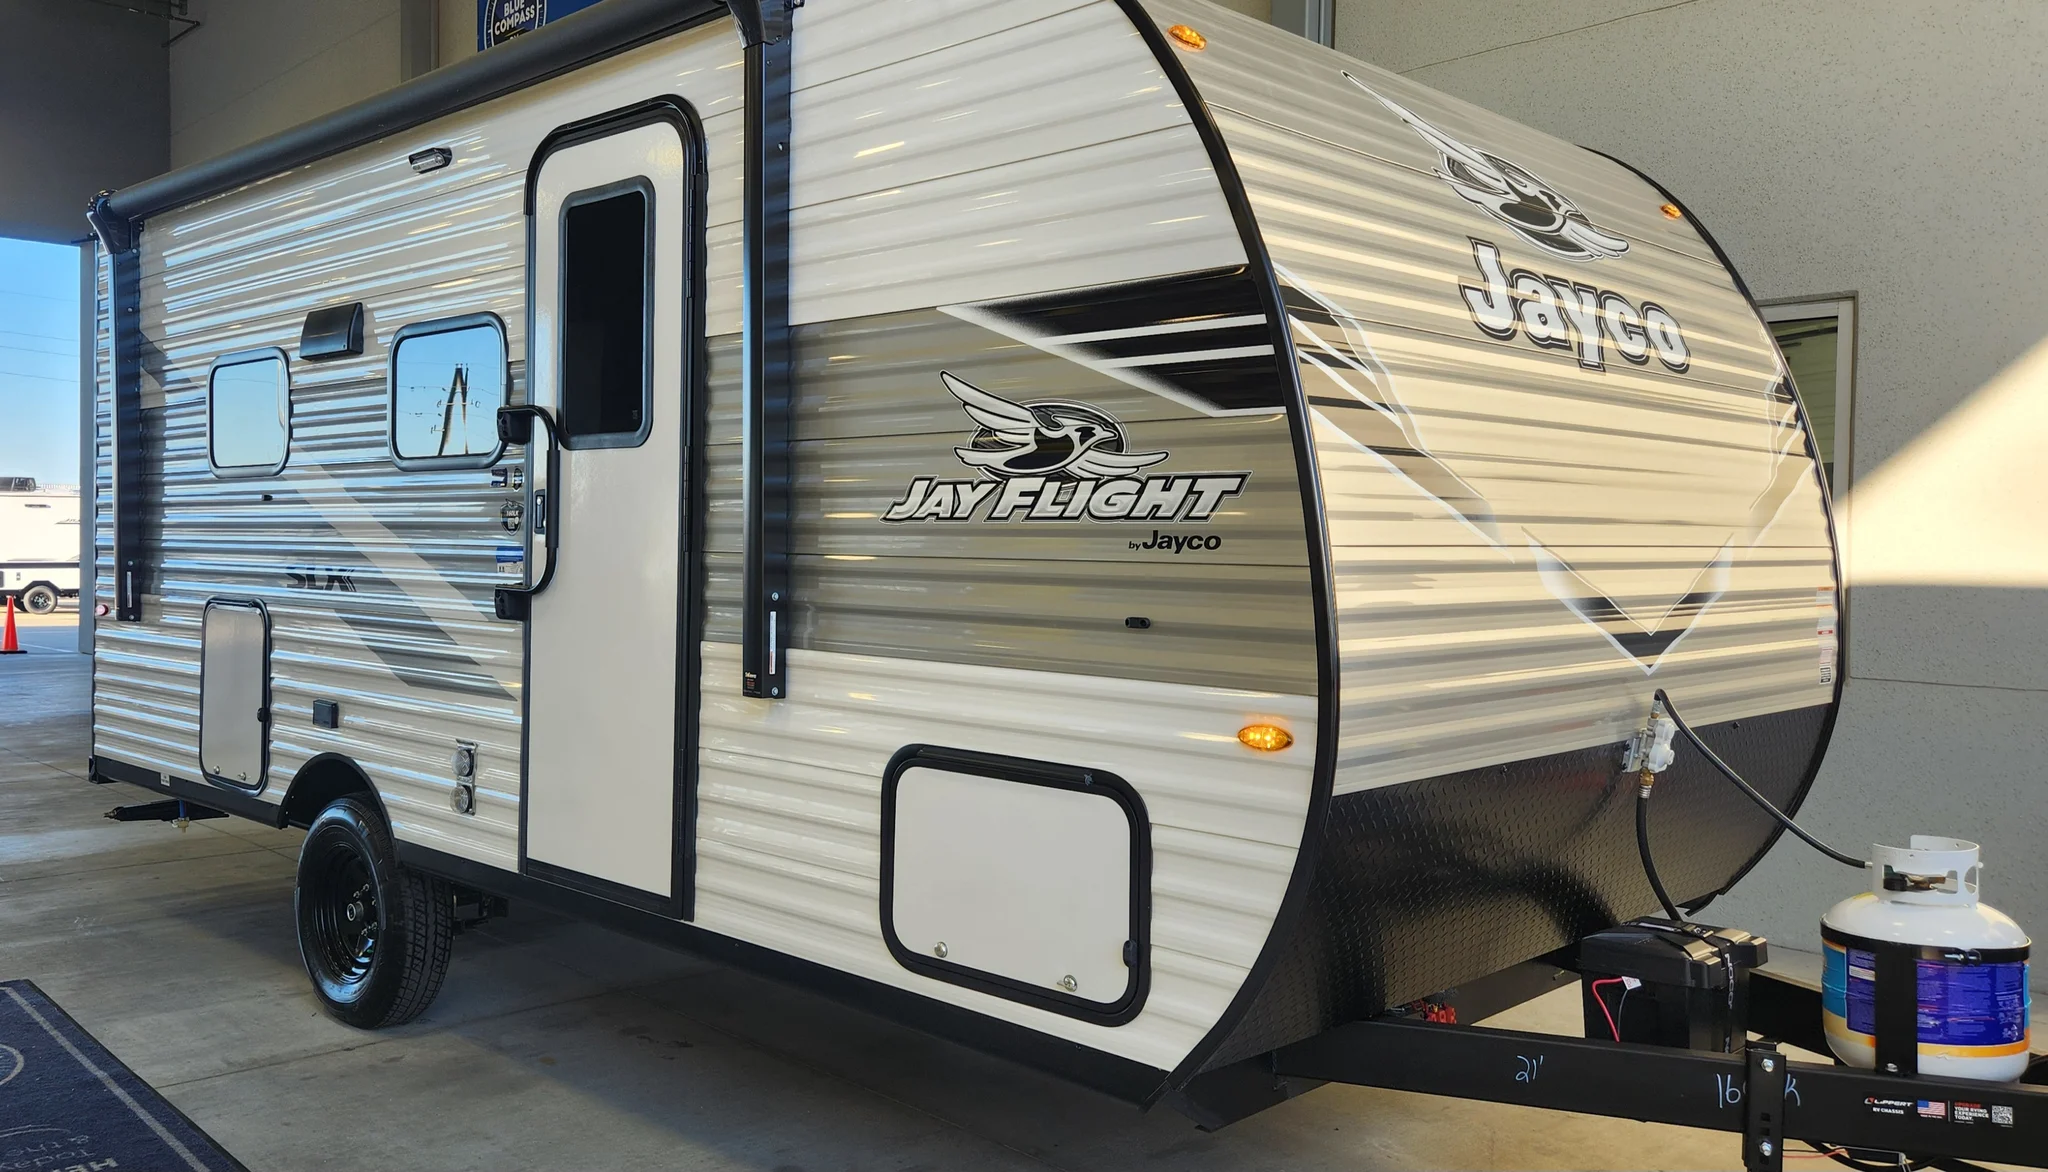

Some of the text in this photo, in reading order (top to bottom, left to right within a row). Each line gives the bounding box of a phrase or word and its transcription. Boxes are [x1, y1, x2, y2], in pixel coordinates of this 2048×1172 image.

[494, 4, 535, 35] COMPASS
[504, 0, 525, 17] BLUE
[1458, 236, 1691, 374] Jayco
[881, 470, 1253, 524] JAY FLIGHT
[1128, 530, 1222, 554] by Jayco
[285, 566, 357, 592] SLX
